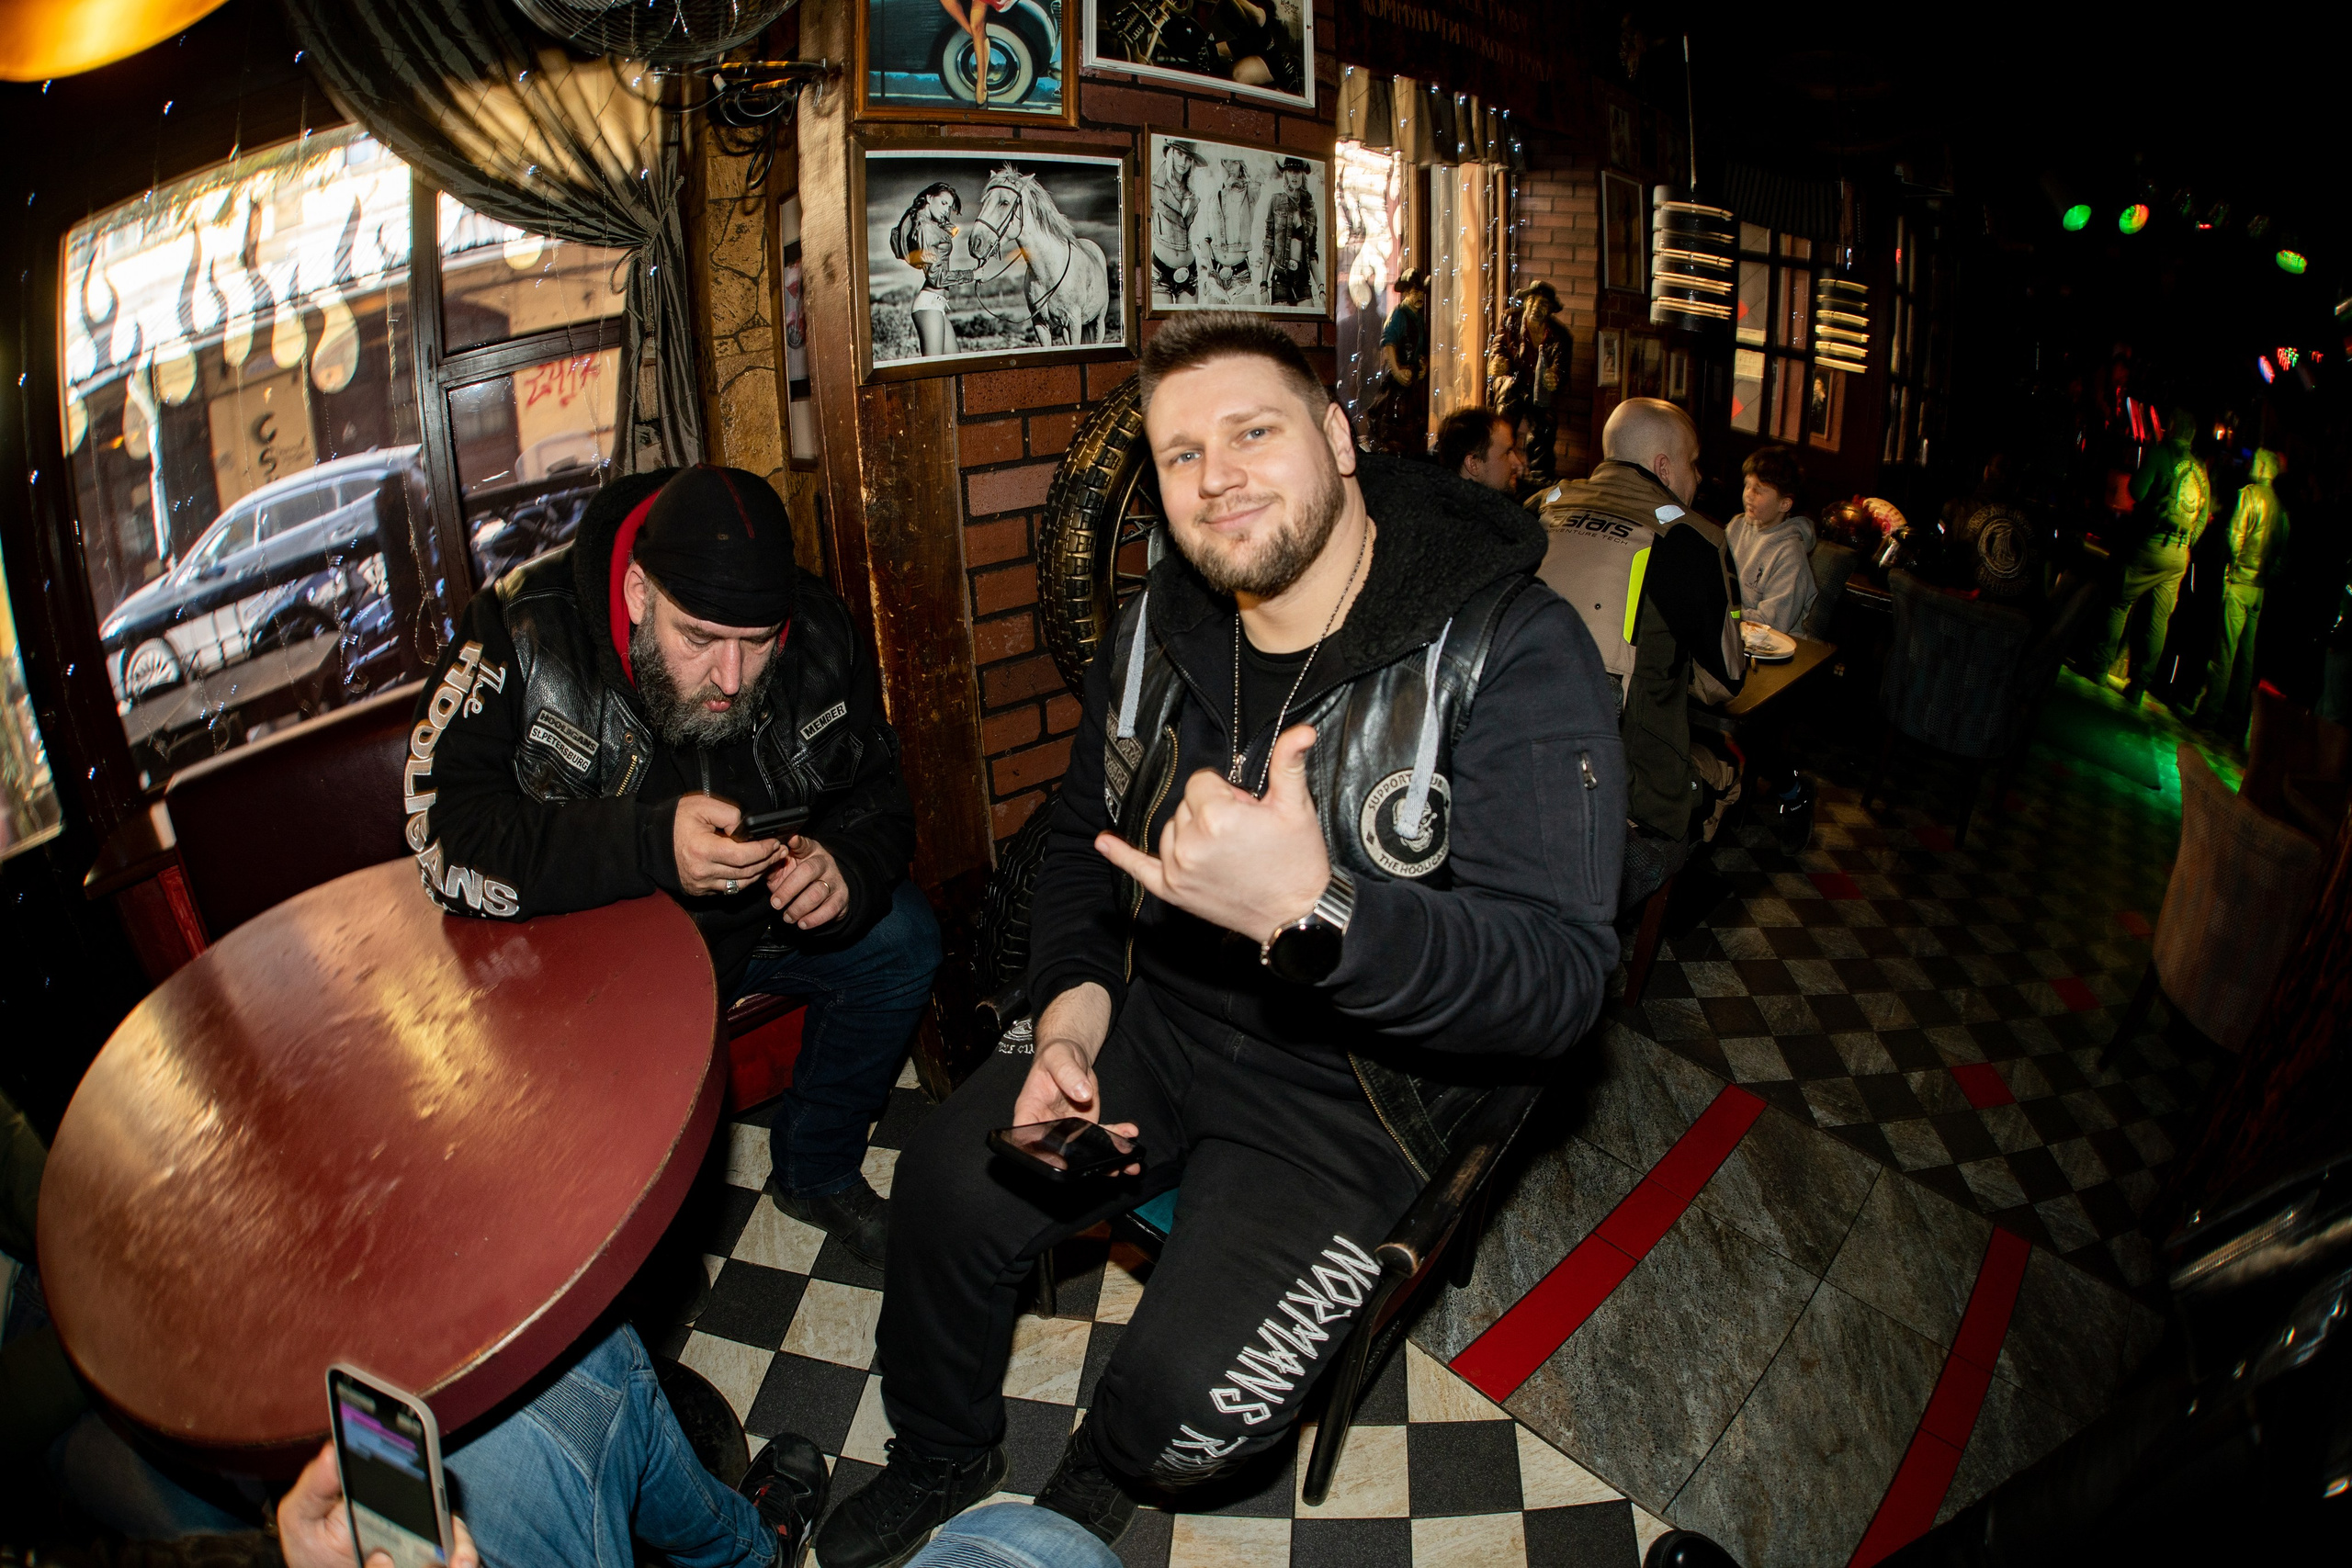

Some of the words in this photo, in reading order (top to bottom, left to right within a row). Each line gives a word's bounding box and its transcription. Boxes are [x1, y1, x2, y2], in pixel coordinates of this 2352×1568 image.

[1602, 535, 1628, 546] TECH
[463, 656, 507, 719] The
[540, 713, 596, 751] HOOLIGANS
[803, 705, 844, 738] MEMBER
[403, 640, 520, 918] HOOLIGANS
[1380, 853, 1399, 870] THE
[1209, 1235, 1381, 1425] NORMANS
